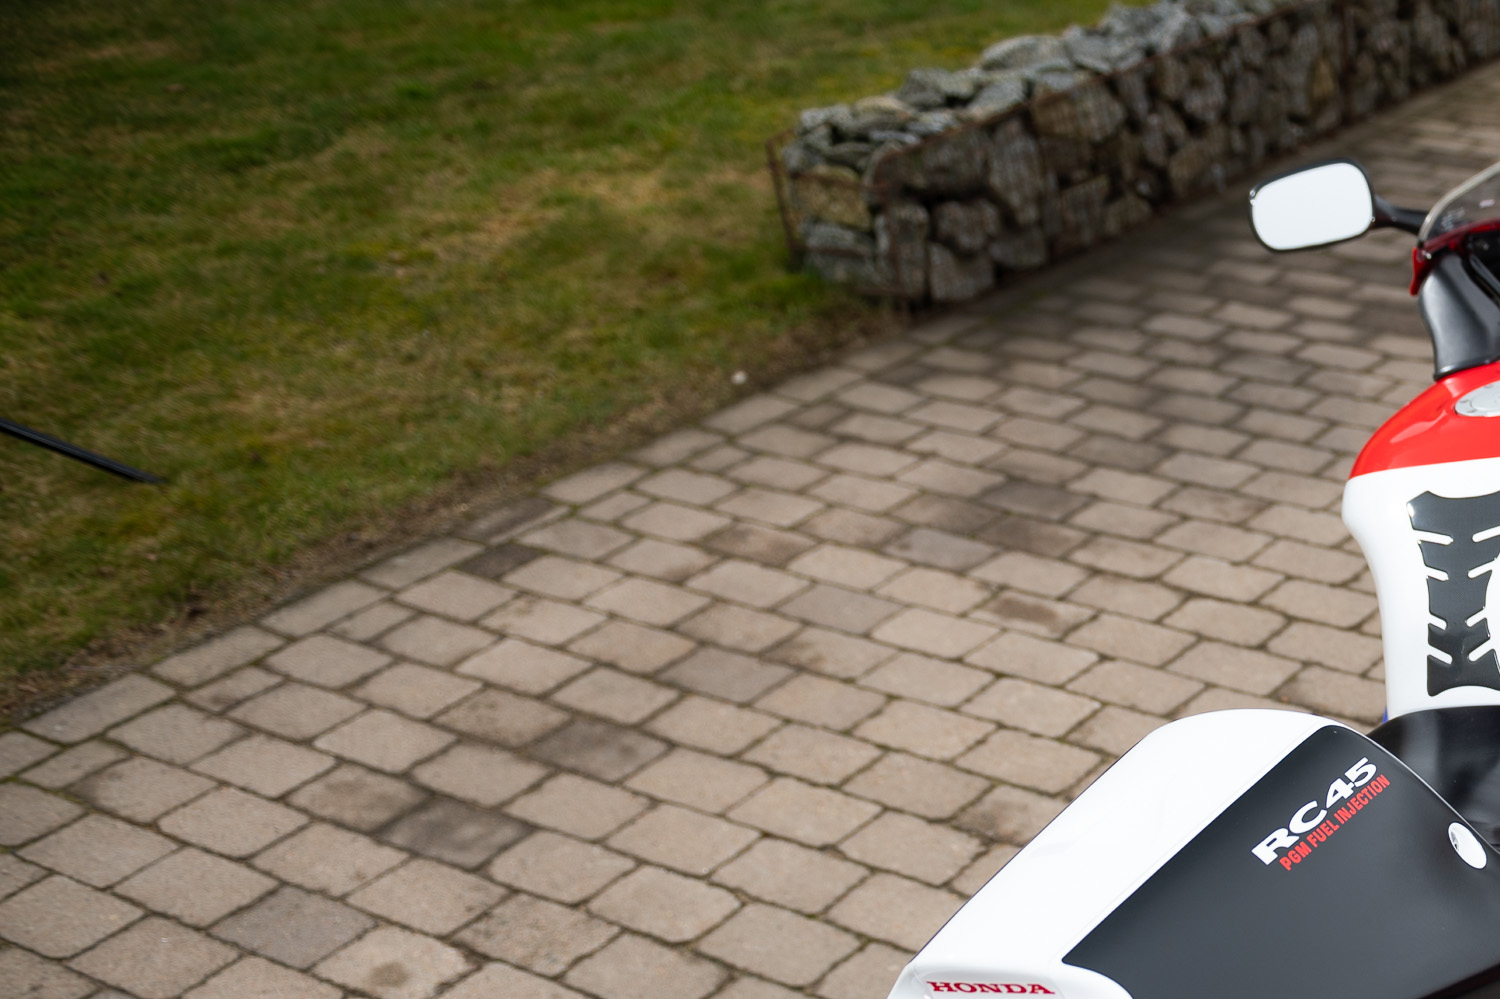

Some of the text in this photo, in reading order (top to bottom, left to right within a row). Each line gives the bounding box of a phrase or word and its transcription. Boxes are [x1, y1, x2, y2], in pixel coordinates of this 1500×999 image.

[1251, 757, 1377, 865] RC45
[1279, 774, 1391, 871] PGM FUEL INJECTION
[926, 981, 1055, 995] HONDA
